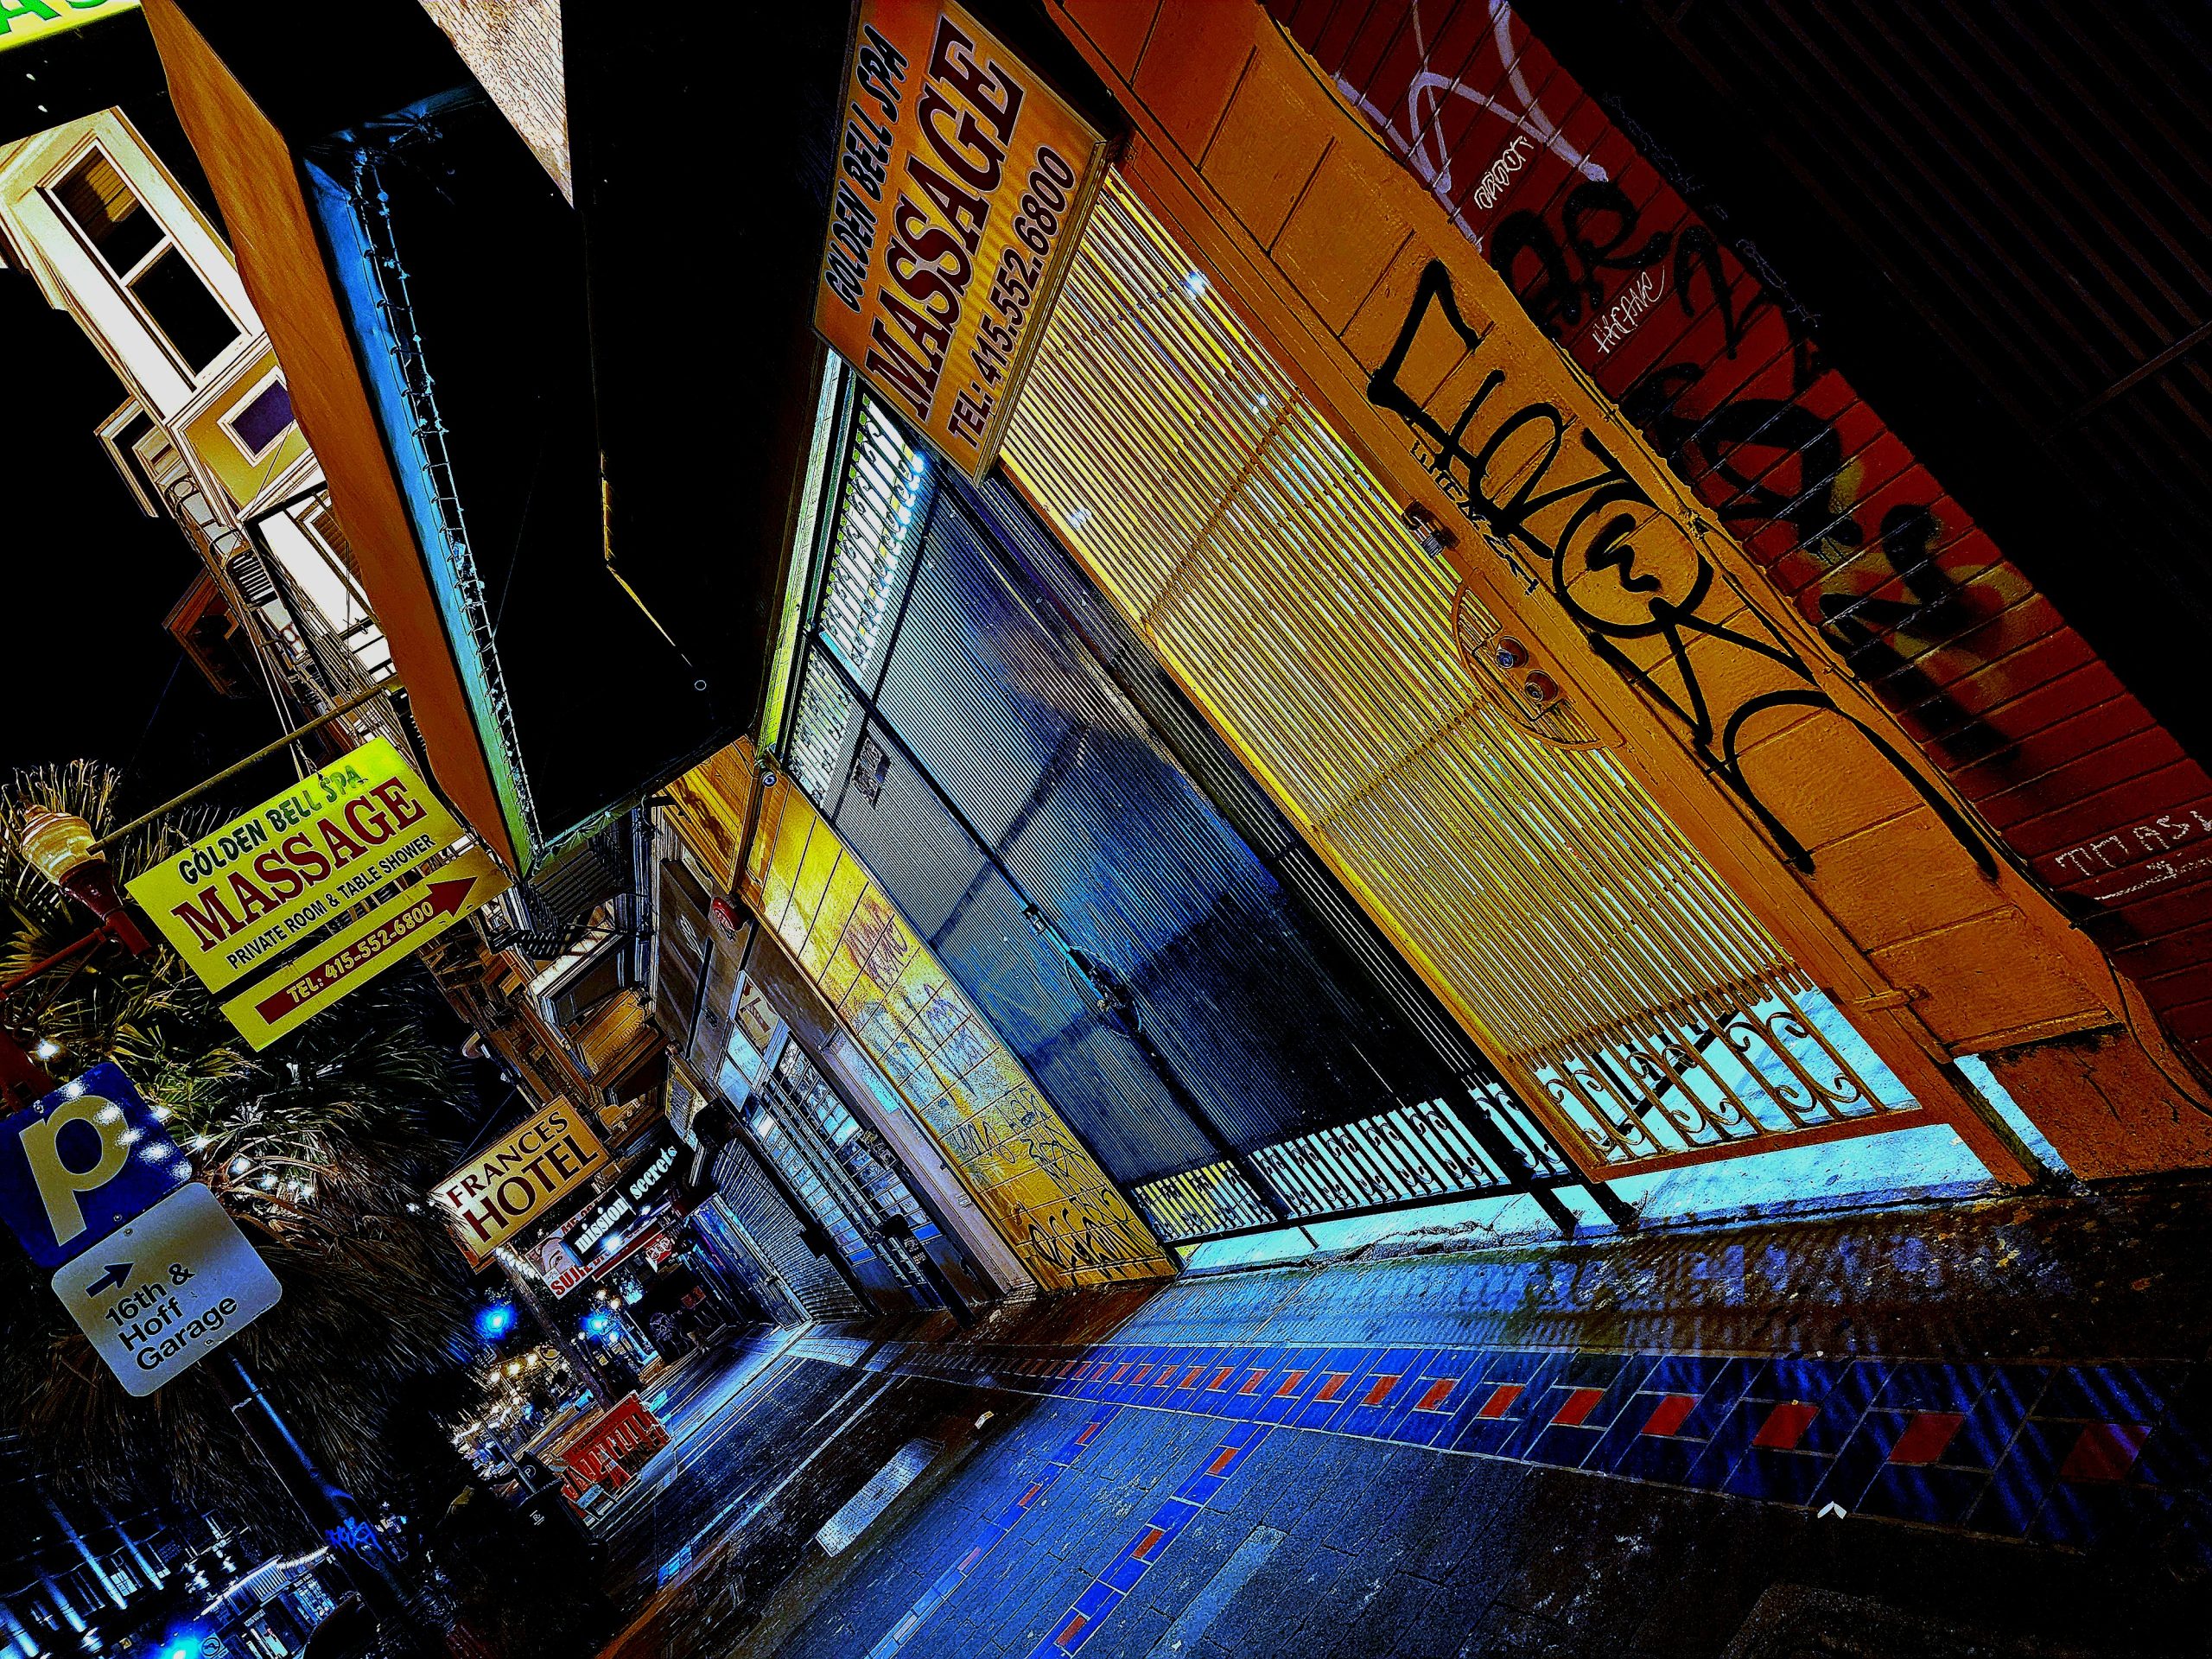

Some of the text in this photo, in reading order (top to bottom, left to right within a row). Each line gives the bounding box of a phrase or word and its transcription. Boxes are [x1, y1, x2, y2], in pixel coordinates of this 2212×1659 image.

[823, 23, 911, 314] GOLDEN BELL SPA
[865, 14, 1026, 423] MASSAGE
[947, 143, 1076, 448] TEL: 415.552.6800
[171, 774, 429, 952] MASSAGE
[179, 763, 364, 885] GOLDEN BELL SPA
[225, 832, 435, 970] PRIVATE ROOM & TABLE SHOWER
[287, 899, 435, 1004] TEL: 415-552-6800
[446, 1109, 569, 1209] FRANCES
[463, 1141, 600, 1244] HOTEL
[575, 1196, 629, 1254] mission
[629, 1146, 677, 1201] secrets
[105, 1262, 195, 1328] 16th &
[119, 1300, 184, 1354] Hoff
[136, 1295, 238, 1373] Garage
